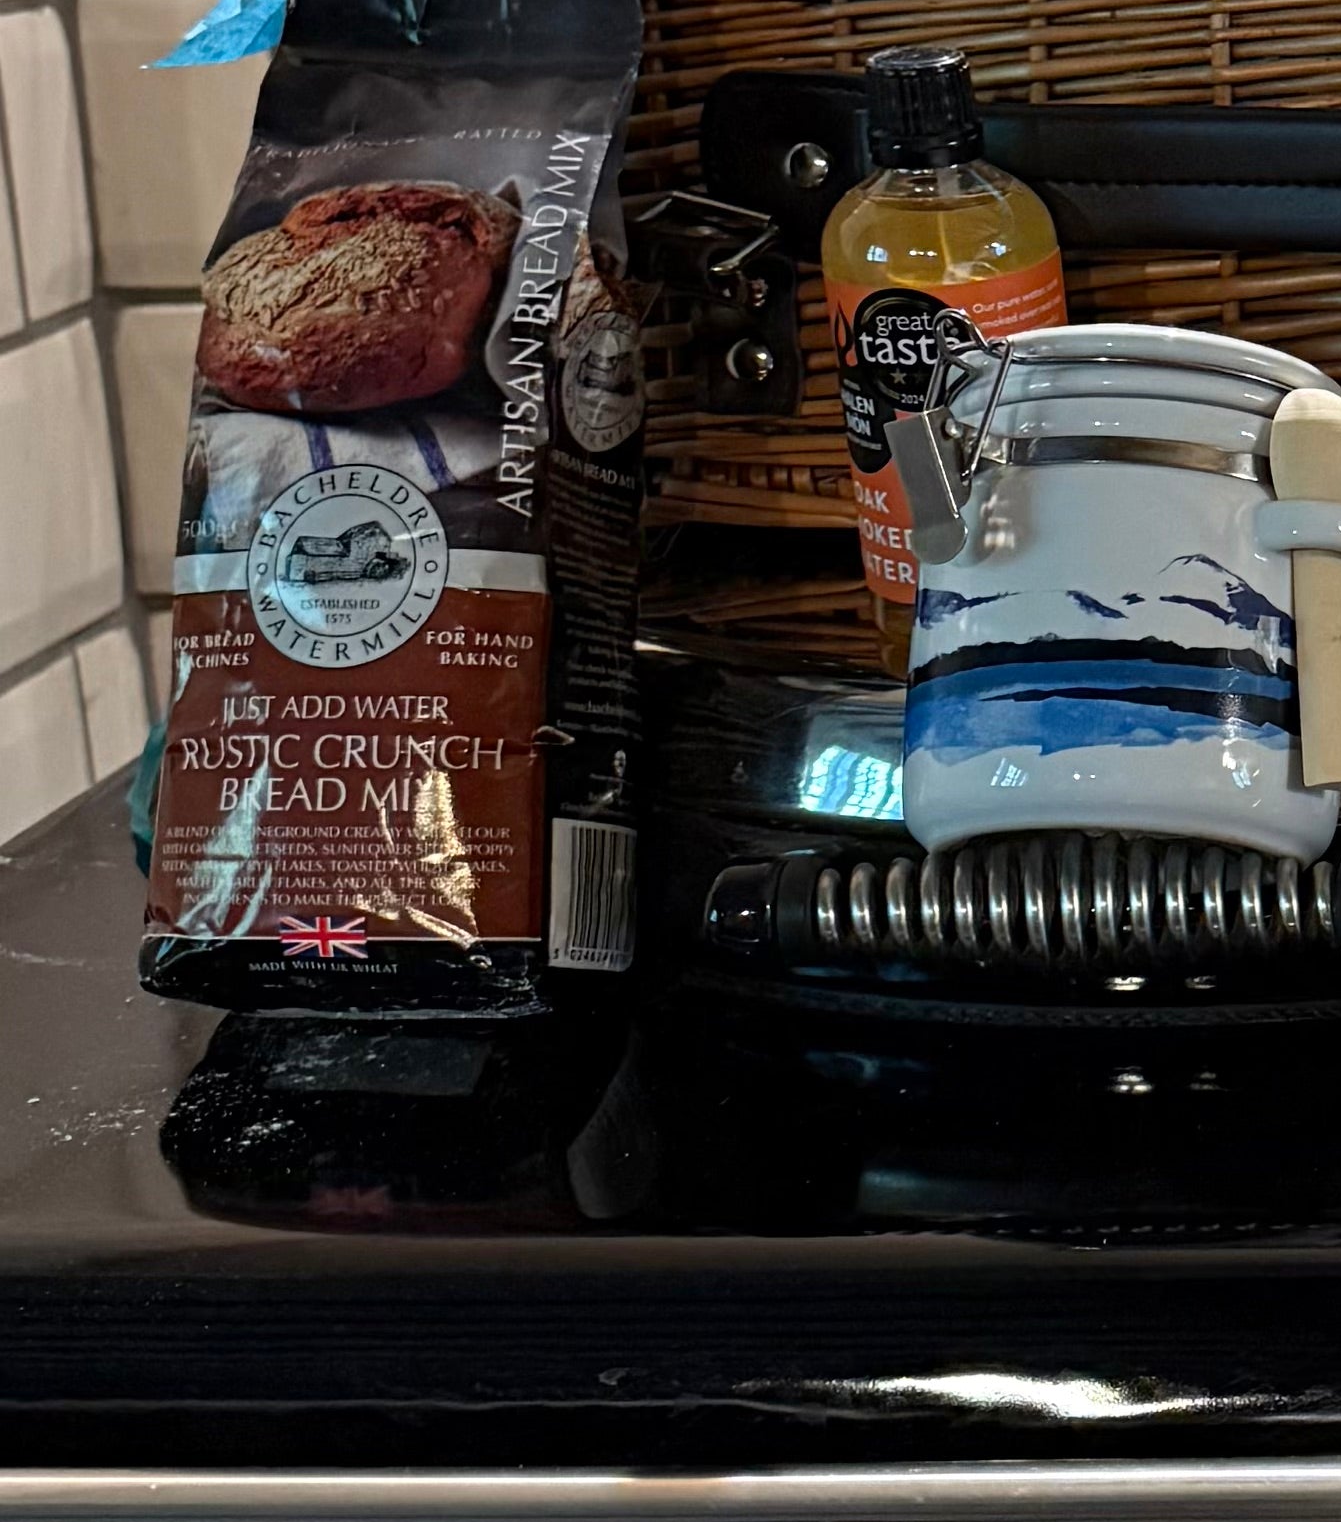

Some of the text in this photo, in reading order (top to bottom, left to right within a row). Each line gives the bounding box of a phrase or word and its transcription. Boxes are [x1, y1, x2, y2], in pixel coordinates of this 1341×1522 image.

[454, 128, 543, 140] RAFTED
[972, 302, 996, 314] Our
[496, 133, 593, 519] ARTISAN BREAD MIX
[875, 312, 935, 337] great
[977, 313, 1018, 328] moked
[854, 480, 890, 514] OAK
[259, 471, 440, 548] BACHELDRE
[300, 598, 381, 611] ESTABLISHED
[257, 587, 437, 662] WATERMILL
[204, 631, 256, 648] BREAD
[425, 630, 534, 650] FOR HAND
[439, 651, 519, 669] BAKING
[223, 695, 449, 723] JUST ADD WATER
[180, 734, 505, 771] RUSTIC CRUNCH
[218, 777, 347, 813] BREAD
[322, 842, 412, 856] SUNFLOWER
[331, 859, 394, 873] TOASTED
[332, 877, 367, 889] AND
[401, 877, 426, 890] THE
[271, 893, 291, 905] TO
[294, 893, 331, 906] MAKE
[248, 960, 287, 972] MADE
[291, 960, 327, 971] WITH
[351, 963, 400, 975] WHEAT
